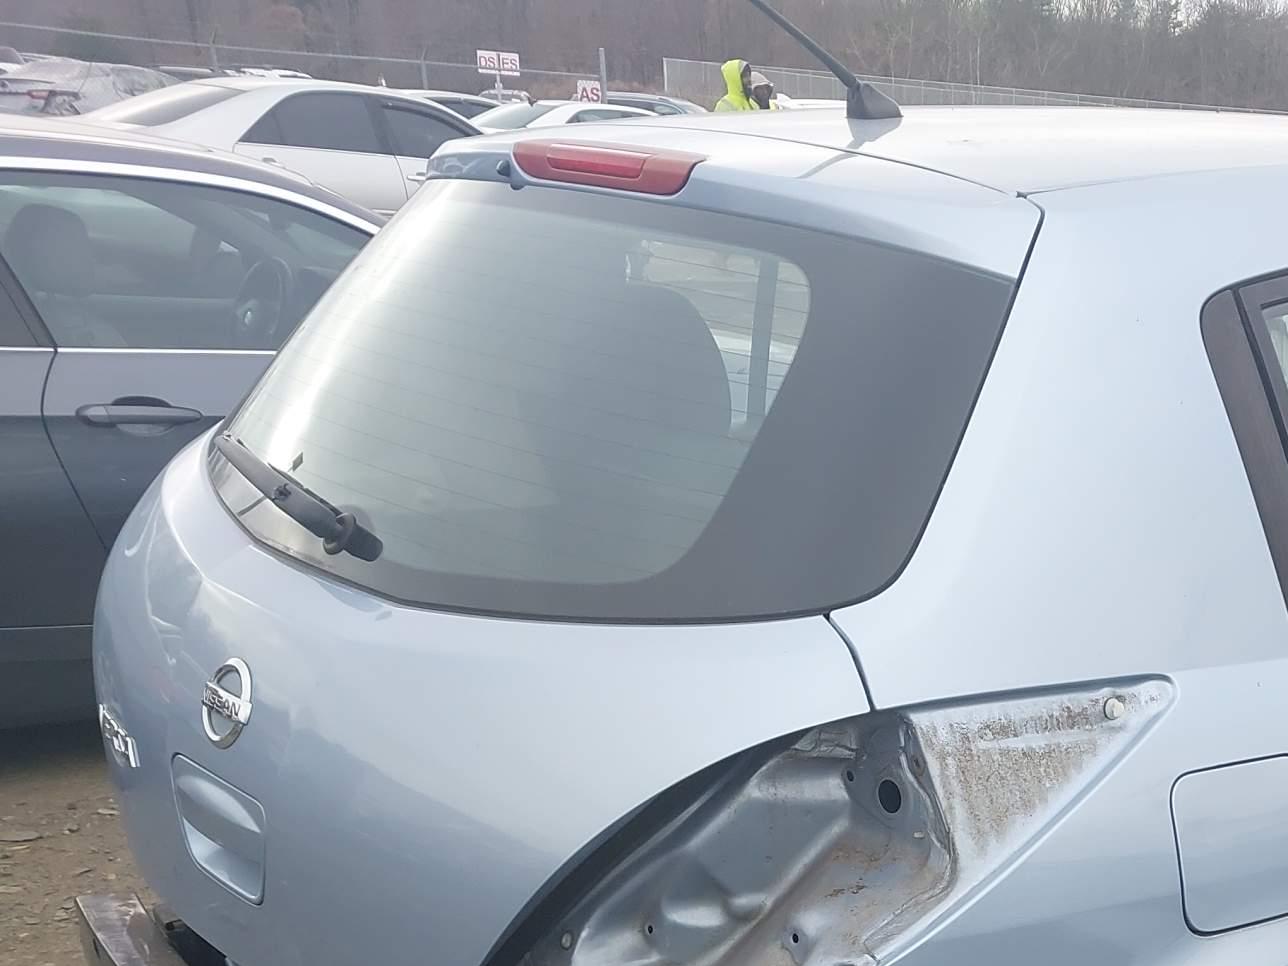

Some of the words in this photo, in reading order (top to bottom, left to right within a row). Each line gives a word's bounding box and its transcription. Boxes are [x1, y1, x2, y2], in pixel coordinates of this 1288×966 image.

[479, 56, 497, 70] DS
[579, 87, 600, 102] AS
[203, 686, 242, 719] NISSAN
